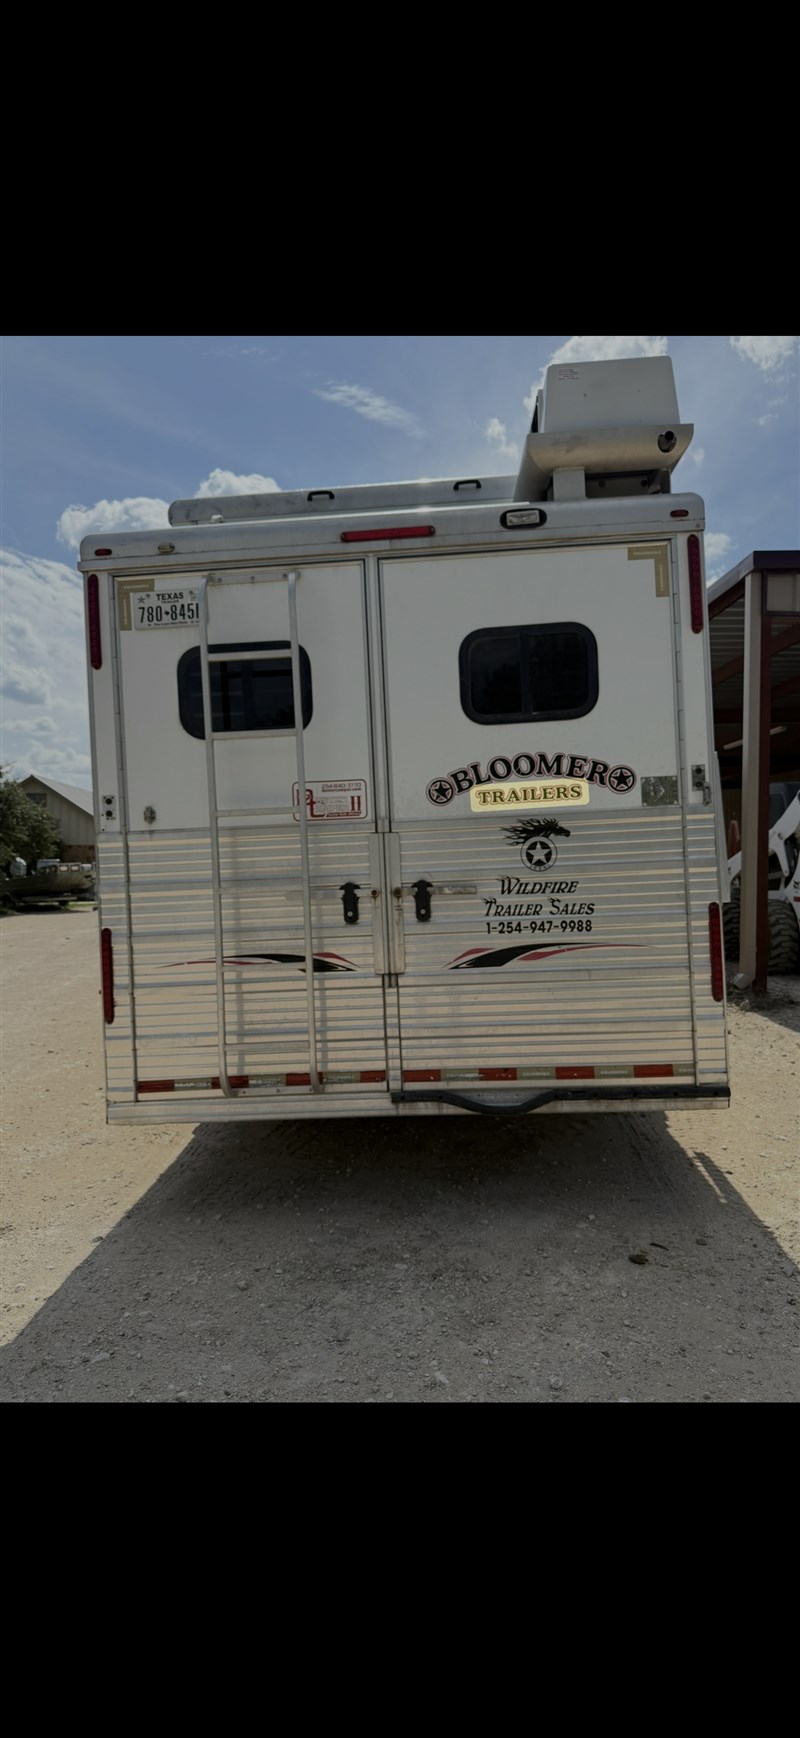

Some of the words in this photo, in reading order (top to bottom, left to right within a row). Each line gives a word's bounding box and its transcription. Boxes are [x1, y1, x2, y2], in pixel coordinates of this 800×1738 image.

[156, 592, 184, 601] TEXAS
[138, 606, 163, 623] 780
[450, 752, 609, 794] BLOOMER
[477, 785, 582, 806] TRAILERS
[497, 874, 579, 895] WILDFIRE
[482, 896, 543, 916] TRAILER
[546, 897, 595, 915] SALES
[486, 920, 592, 934] 1-254-947-9988
